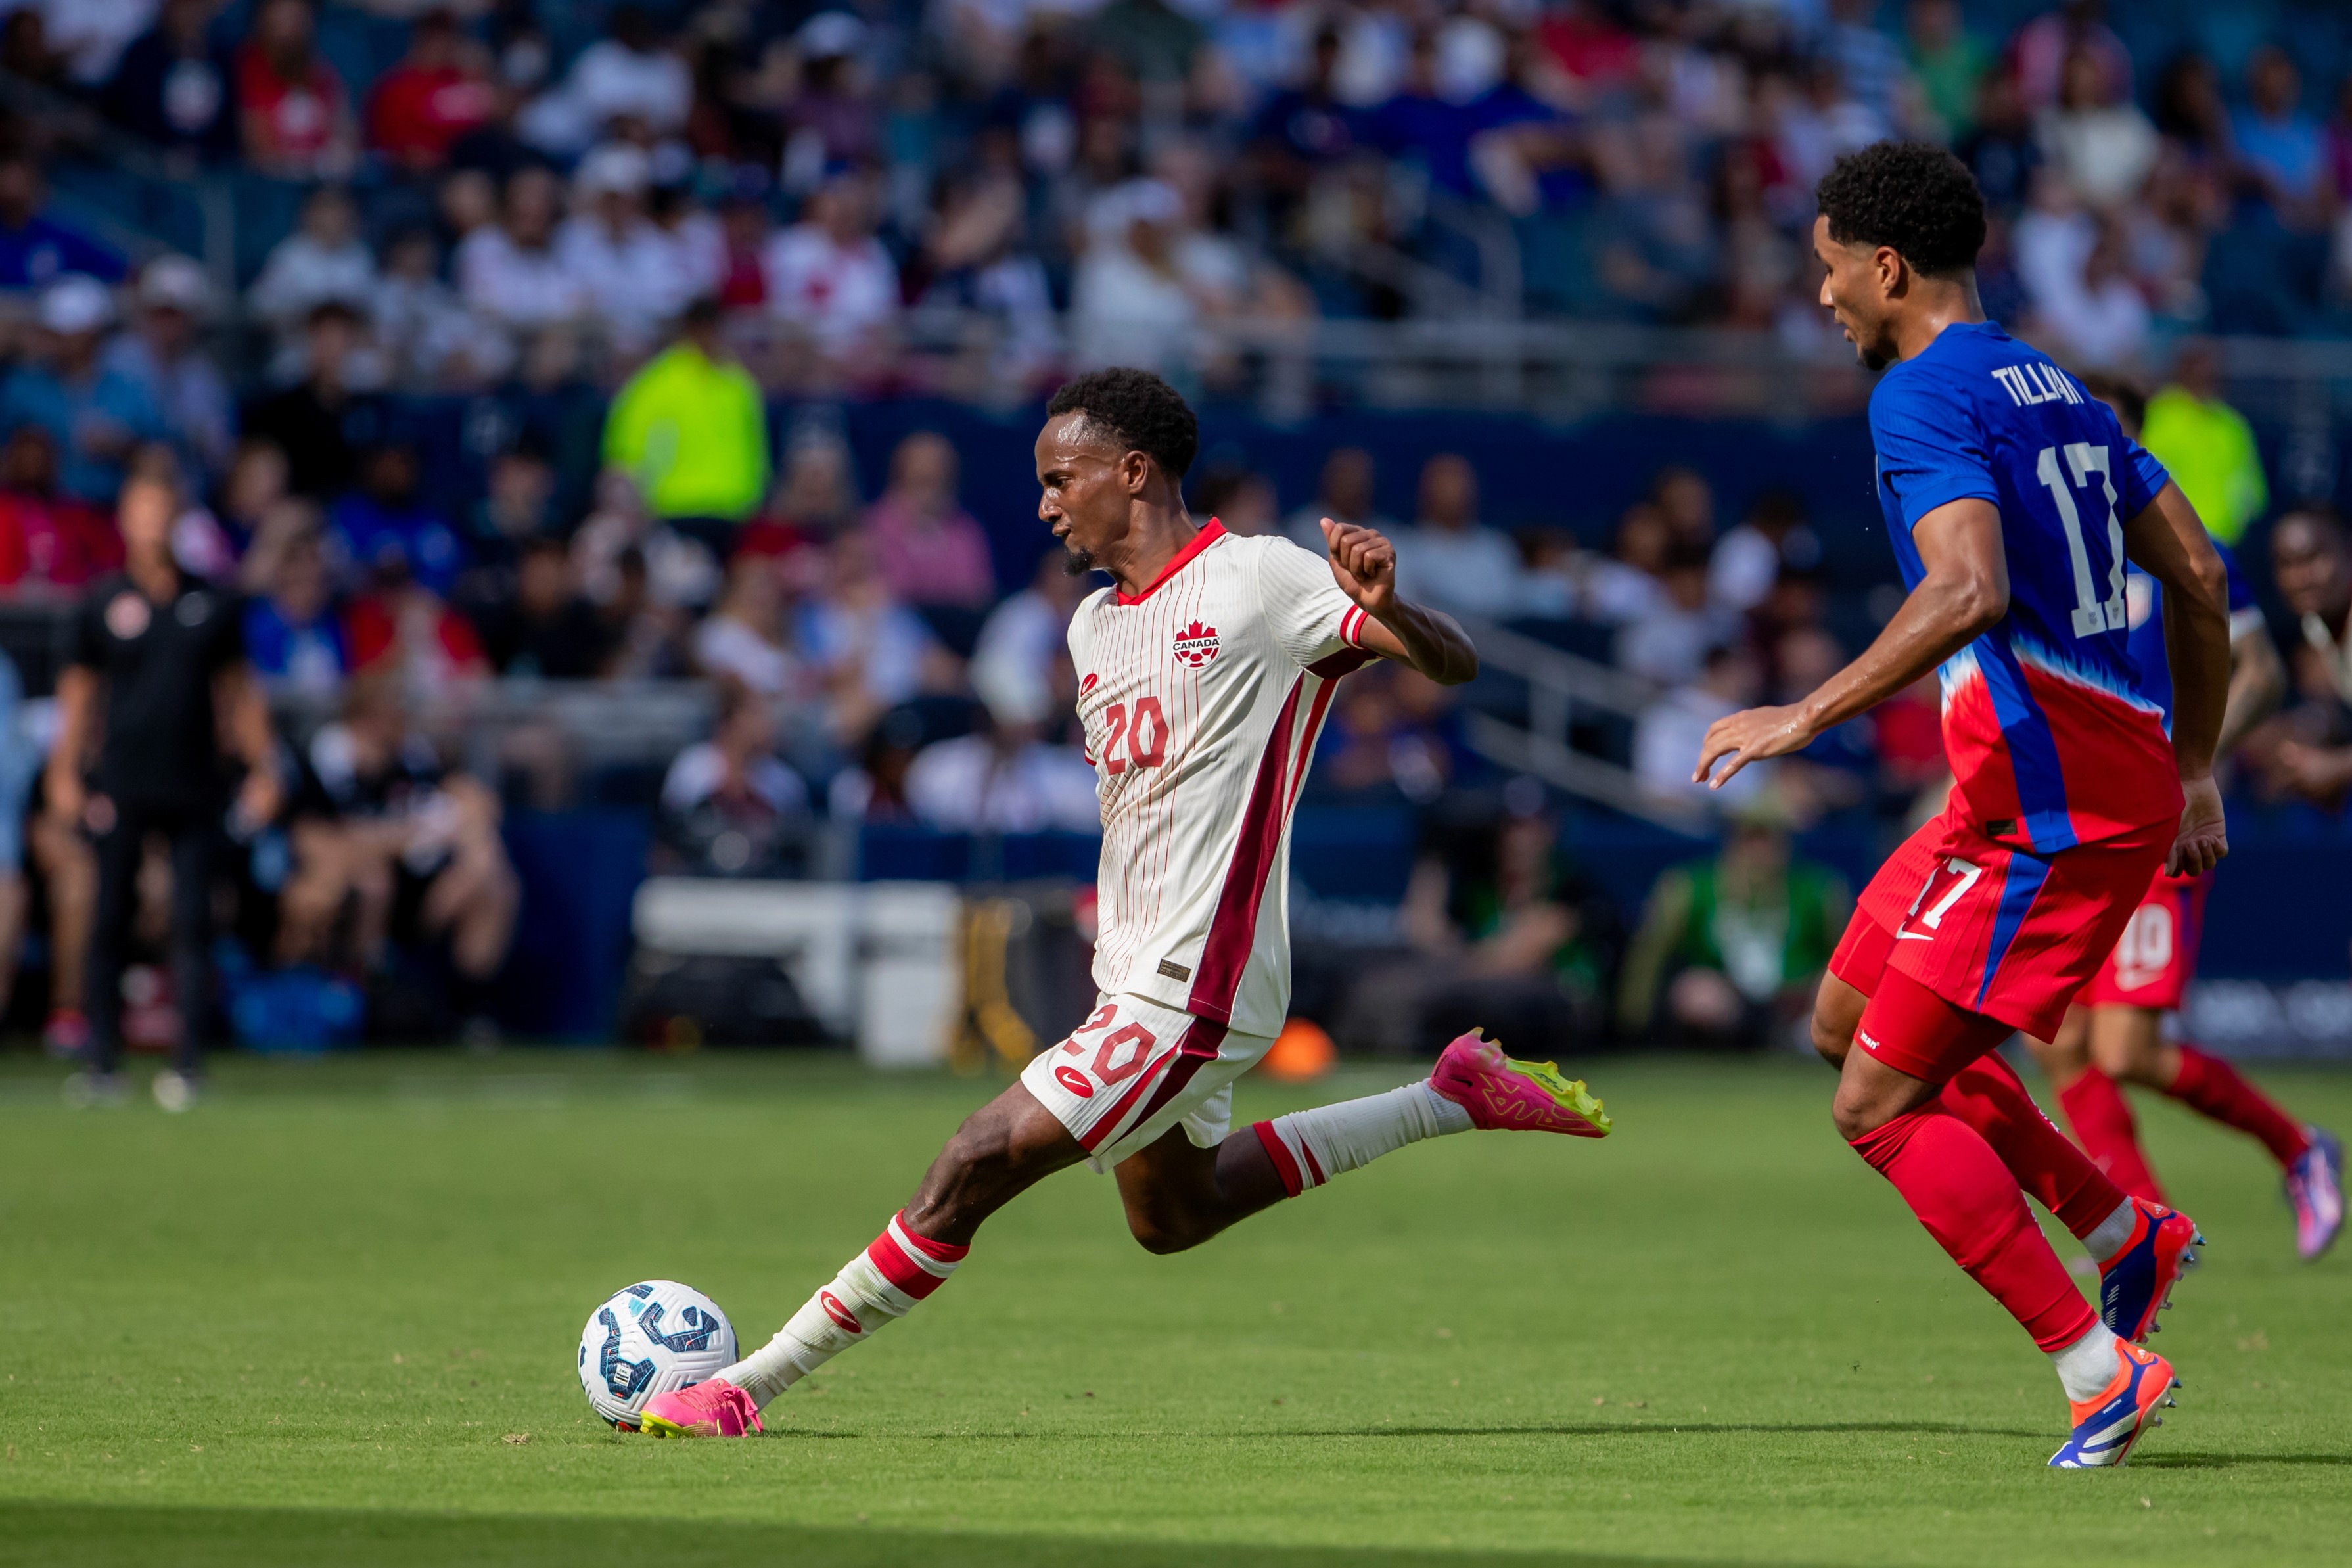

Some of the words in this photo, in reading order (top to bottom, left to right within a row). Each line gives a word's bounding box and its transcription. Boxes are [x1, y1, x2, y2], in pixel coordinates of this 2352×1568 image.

[2037, 442, 2126, 639] 17
[1173, 639, 1220, 651] CANADA
[1103, 696, 1169, 776] 20
[1908, 856, 1983, 931] 17
[1061, 1003, 1157, 1087] 20
